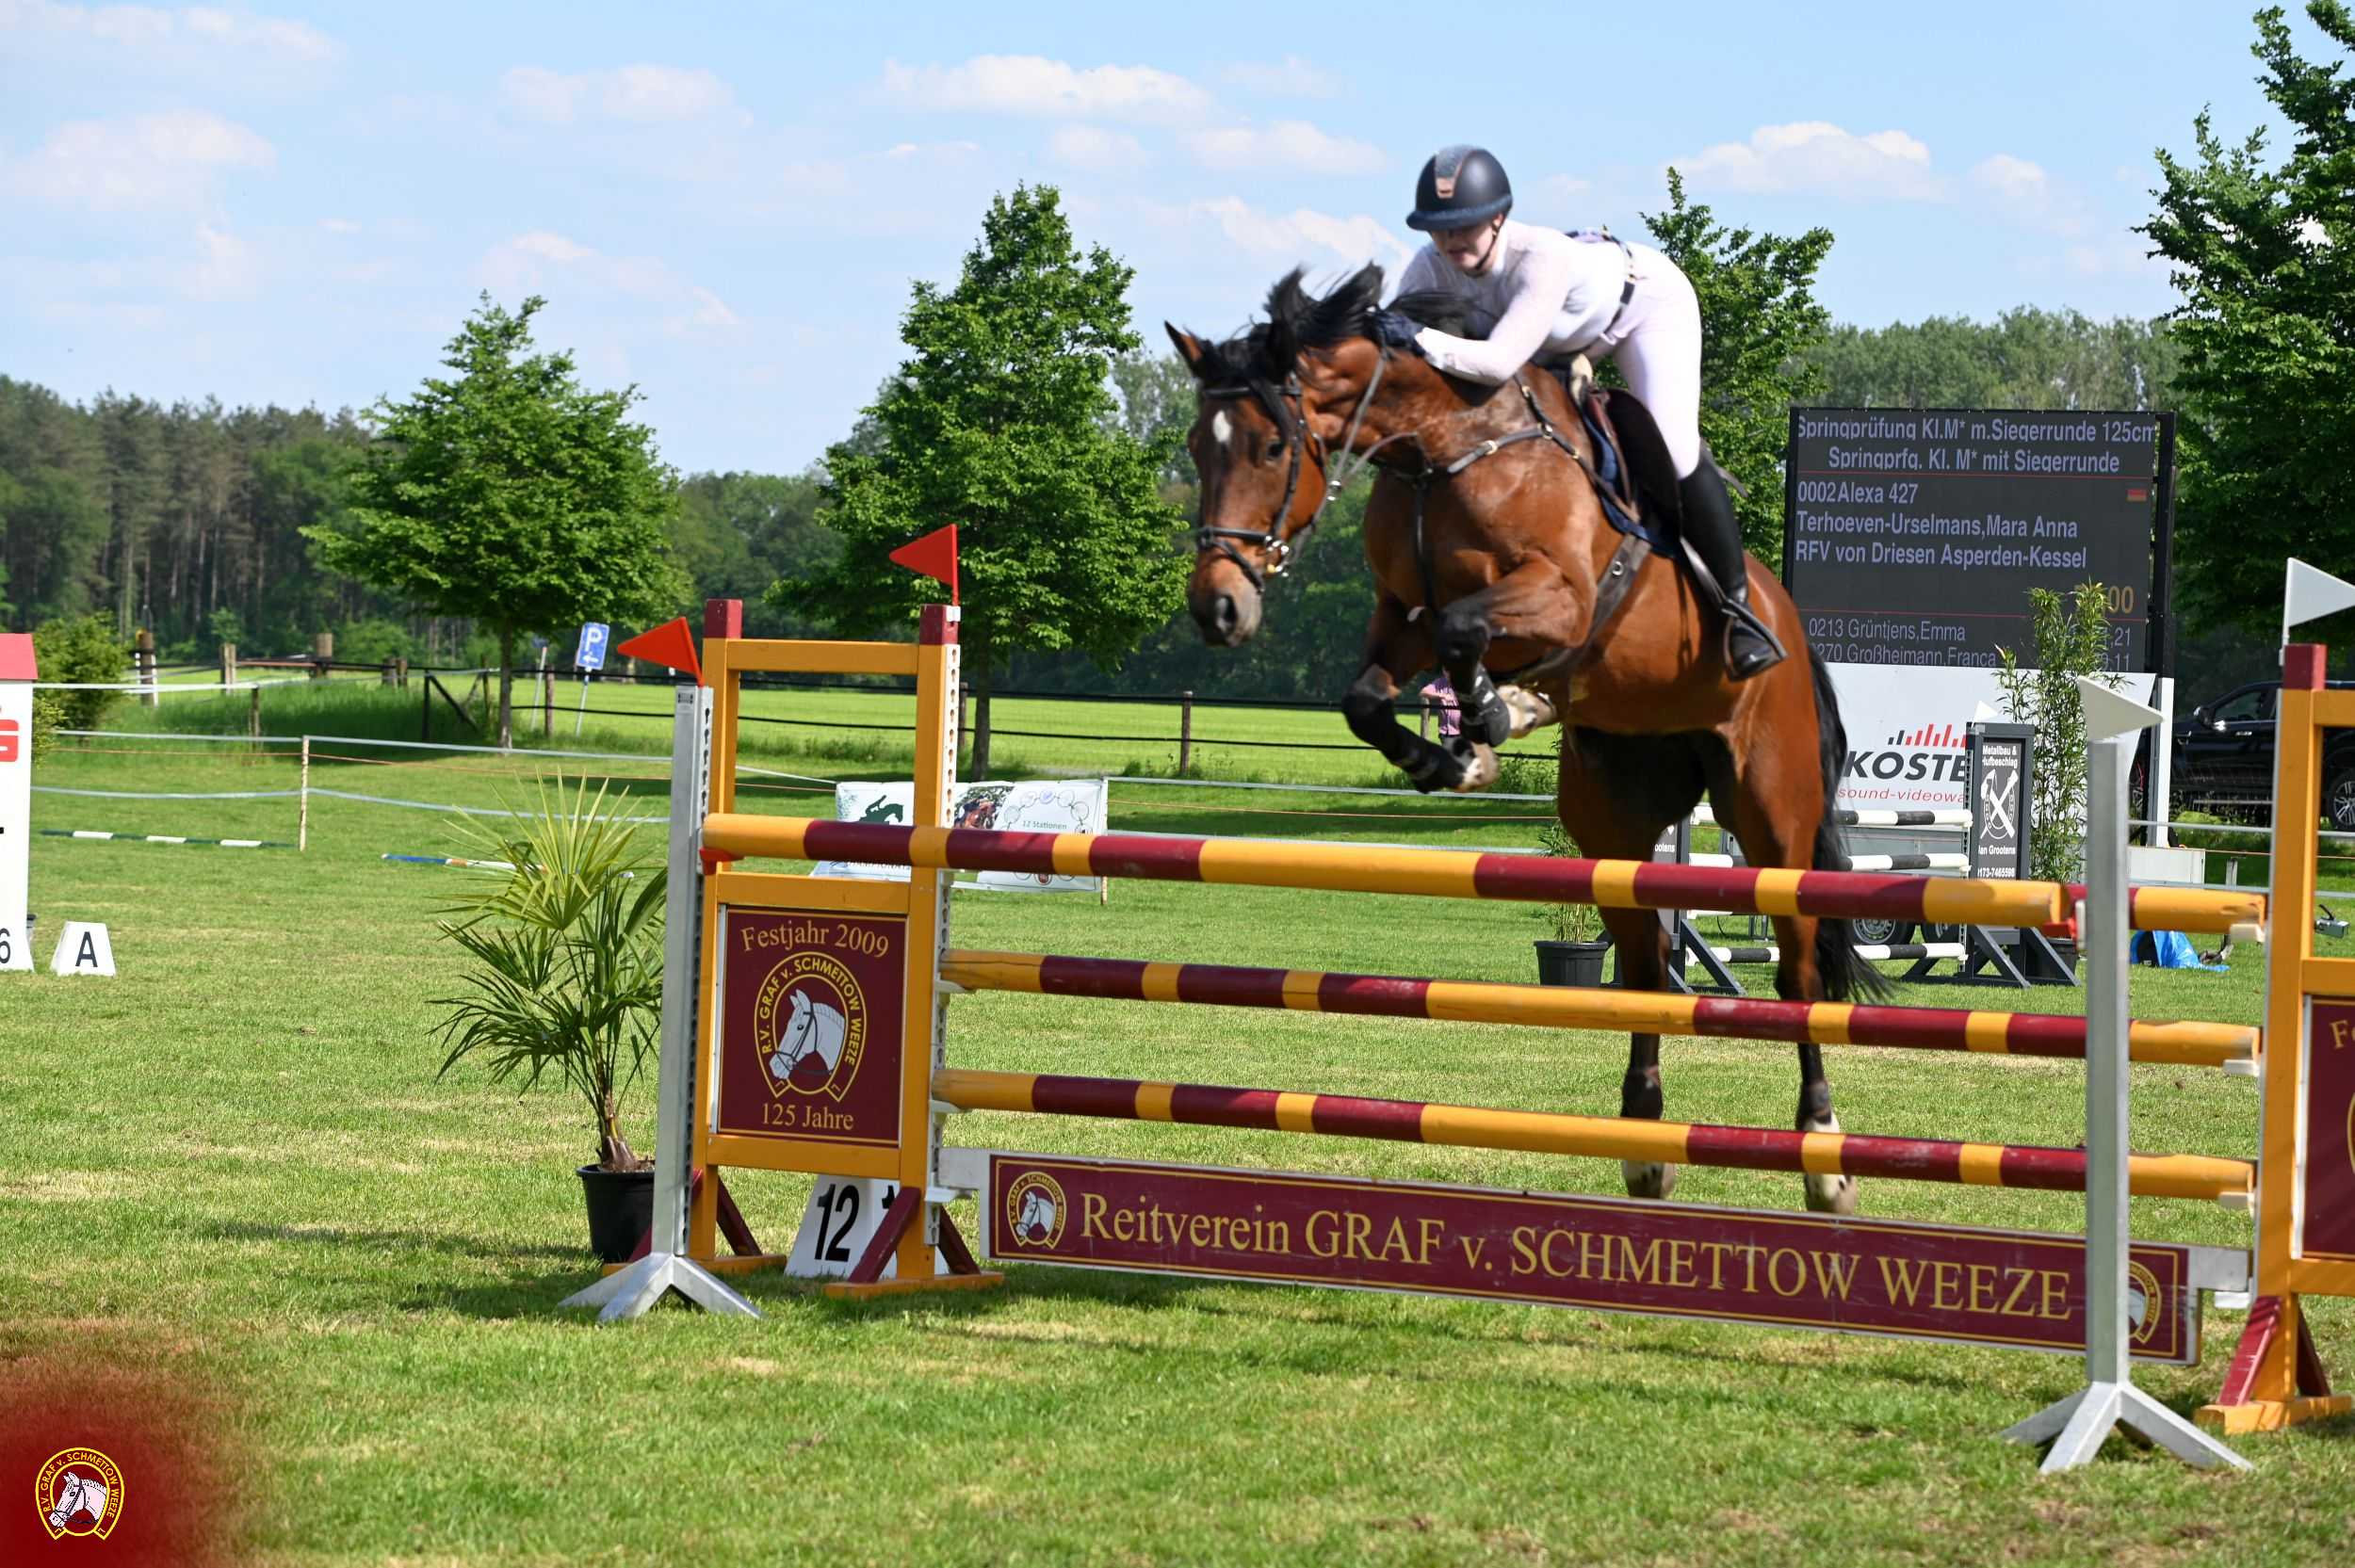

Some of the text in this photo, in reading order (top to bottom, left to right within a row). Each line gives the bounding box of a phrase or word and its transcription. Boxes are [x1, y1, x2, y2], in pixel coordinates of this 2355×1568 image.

[2103, 421, 2155, 443] 125cm
[1928, 447, 1950, 470] Kl.
[1983, 448, 2008, 471] mit
[2014, 449, 2120, 473] Siegerrunde
[1889, 483, 1918, 504] 427
[2033, 515, 2078, 538] Anna
[1795, 540, 2087, 571] RFV von Driesen Asperden-Kessel
[584, 626, 603, 652] P
[1809, 618, 1843, 638] 0213
[1811, 642, 1843, 661] 270
[1982, 745, 2011, 755] Metallbau
[1843, 751, 1966, 782] KOSTE
[1838, 787, 1965, 803] sound-videowa
[75, 931, 98, 967] A
[740, 920, 889, 958] Festjahr 2009
[759, 977, 780, 1020] GRAF
[793, 957, 861, 1010] SCHMETTOW
[844, 1018, 862, 1066] WEEZE
[2330, 1020, 2355, 1049] F
[762, 1103, 854, 1130] 125 Jahre
[814, 1183, 860, 1262] 12
[1080, 1192, 1290, 1254] Reitverein
[1306, 1209, 1445, 1266] GRAF
[1459, 1236, 1493, 1271] v.
[1510, 1225, 1861, 1301] SCHMETTOW
[1876, 1255, 2072, 1320] WEEZE
